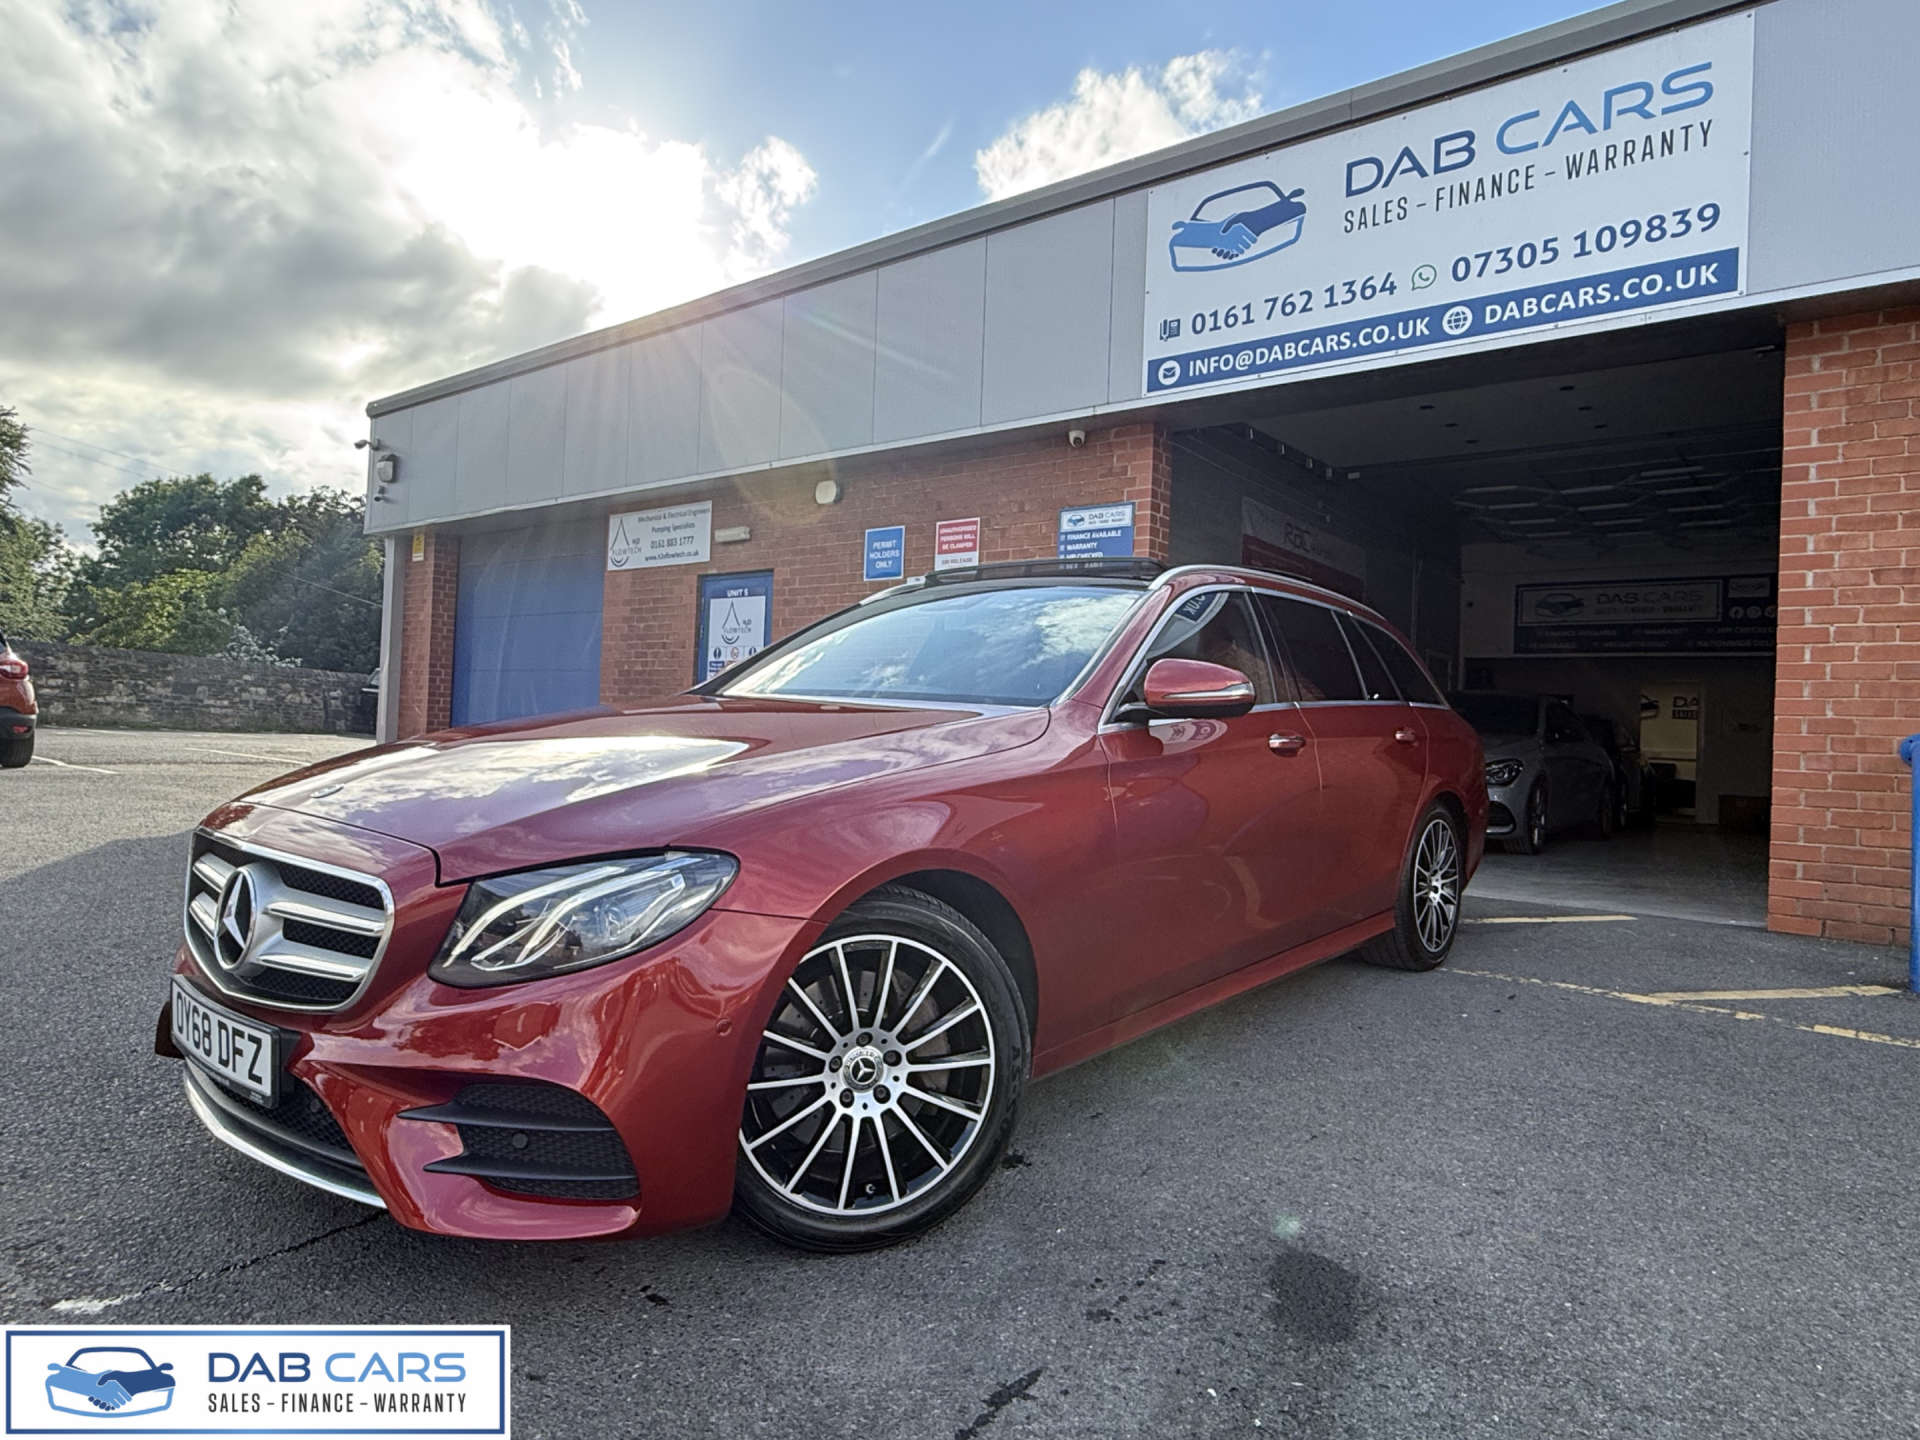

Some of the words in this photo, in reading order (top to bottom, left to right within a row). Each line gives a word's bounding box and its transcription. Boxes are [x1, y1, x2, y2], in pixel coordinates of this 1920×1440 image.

[1345, 129, 1476, 198] DAB
[1496, 61, 1714, 155] CARS
[1344, 196, 1408, 233] SALES
[1435, 164, 1535, 212] FINANCE
[1566, 119, 1713, 180] WARRANTY
[1191, 302, 1255, 335] 0161
[1264, 290, 1313, 321] 762
[1324, 272, 1397, 309] 1364
[1451, 237, 1560, 283] 07305
[1573, 202, 1721, 258] 109839
[1189, 317, 1430, 377] INFO@DABCARS.CO.UK
[1485, 263, 1719, 324] DABCARS.CO.UK
[1092, 529, 1121, 539] AVAILABLE
[873, 540, 897, 550] PERMIT
[1066, 542, 1097, 551] WARRANTY
[870, 549, 900, 559] HOLDERS
[875, 561, 893, 569] ONLY
[727, 588, 743, 597] UNIT
[218, 1019, 262, 1085] DFZ
